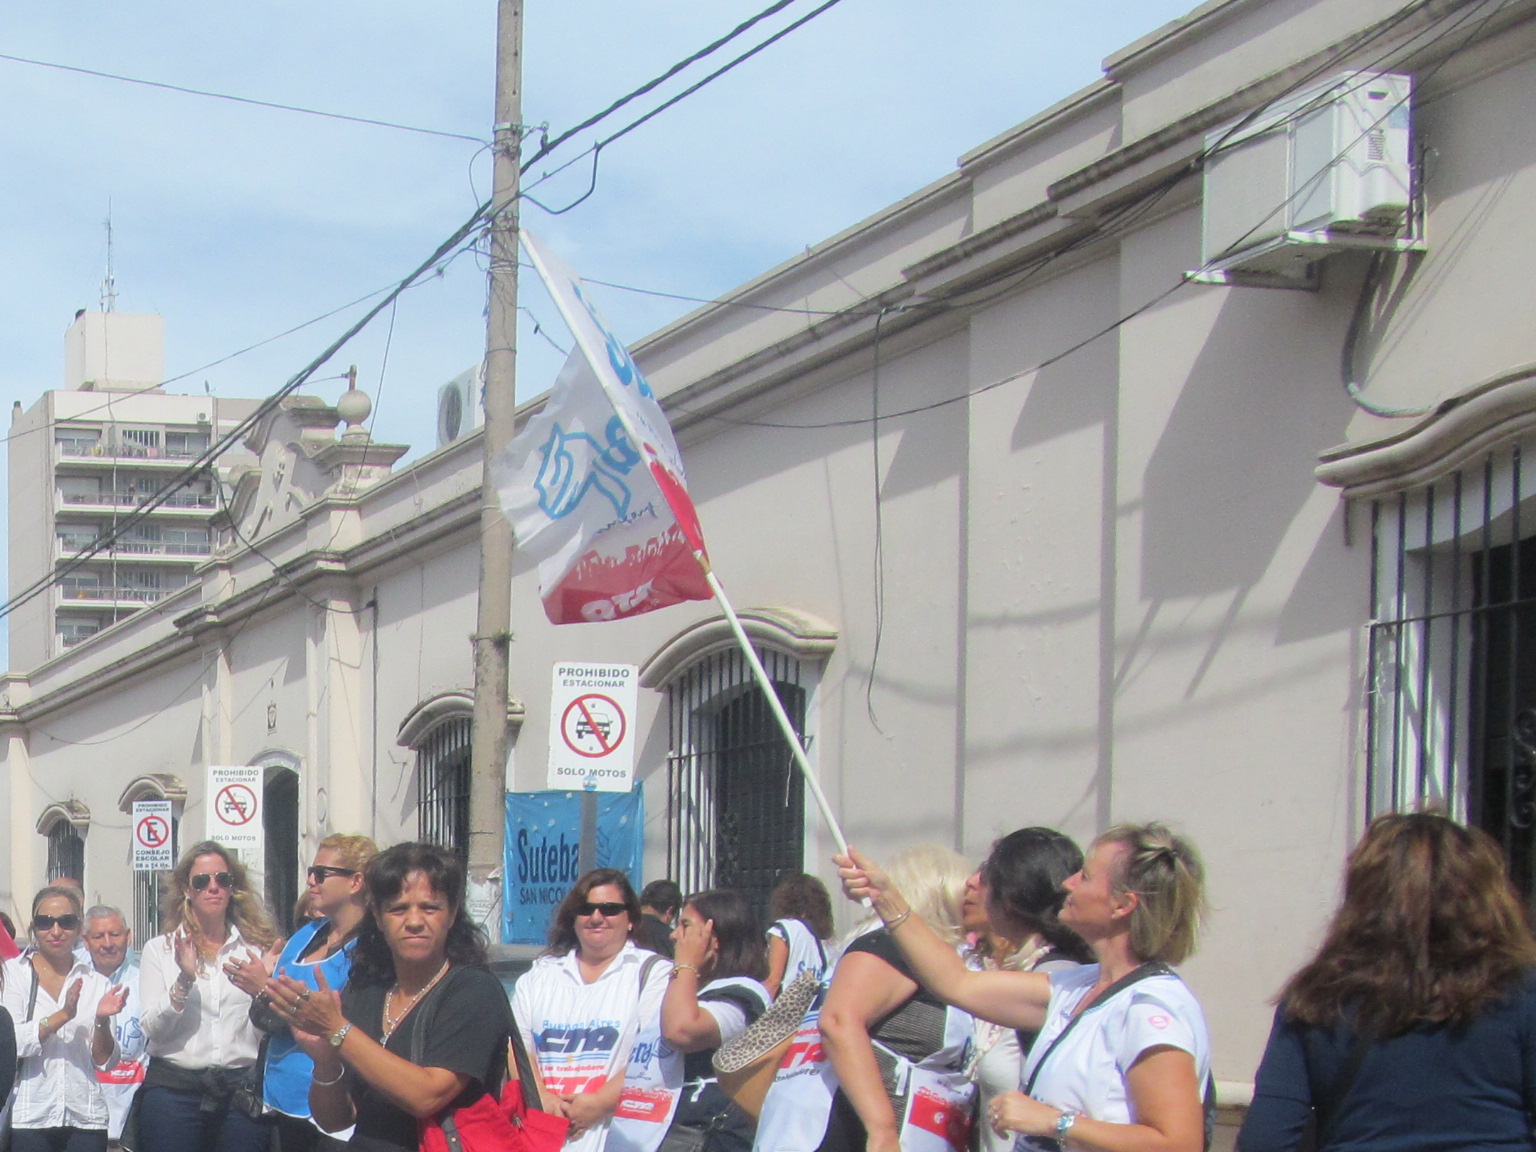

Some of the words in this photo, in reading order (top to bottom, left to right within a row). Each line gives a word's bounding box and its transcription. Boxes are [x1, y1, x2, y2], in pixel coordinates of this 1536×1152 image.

[558, 667, 630, 678] PROHIBIDO
[563, 679, 625, 688] ESTACIONAR
[557, 767, 585, 776] SOLO
[588, 768, 626, 778] MOTOS
[518, 828, 579, 884] Suteba
[519, 886, 538, 905] SAN
[542, 1019, 586, 1030] Buenos
[589, 1018, 621, 1028] Aires
[538, 1026, 620, 1053] CTA
